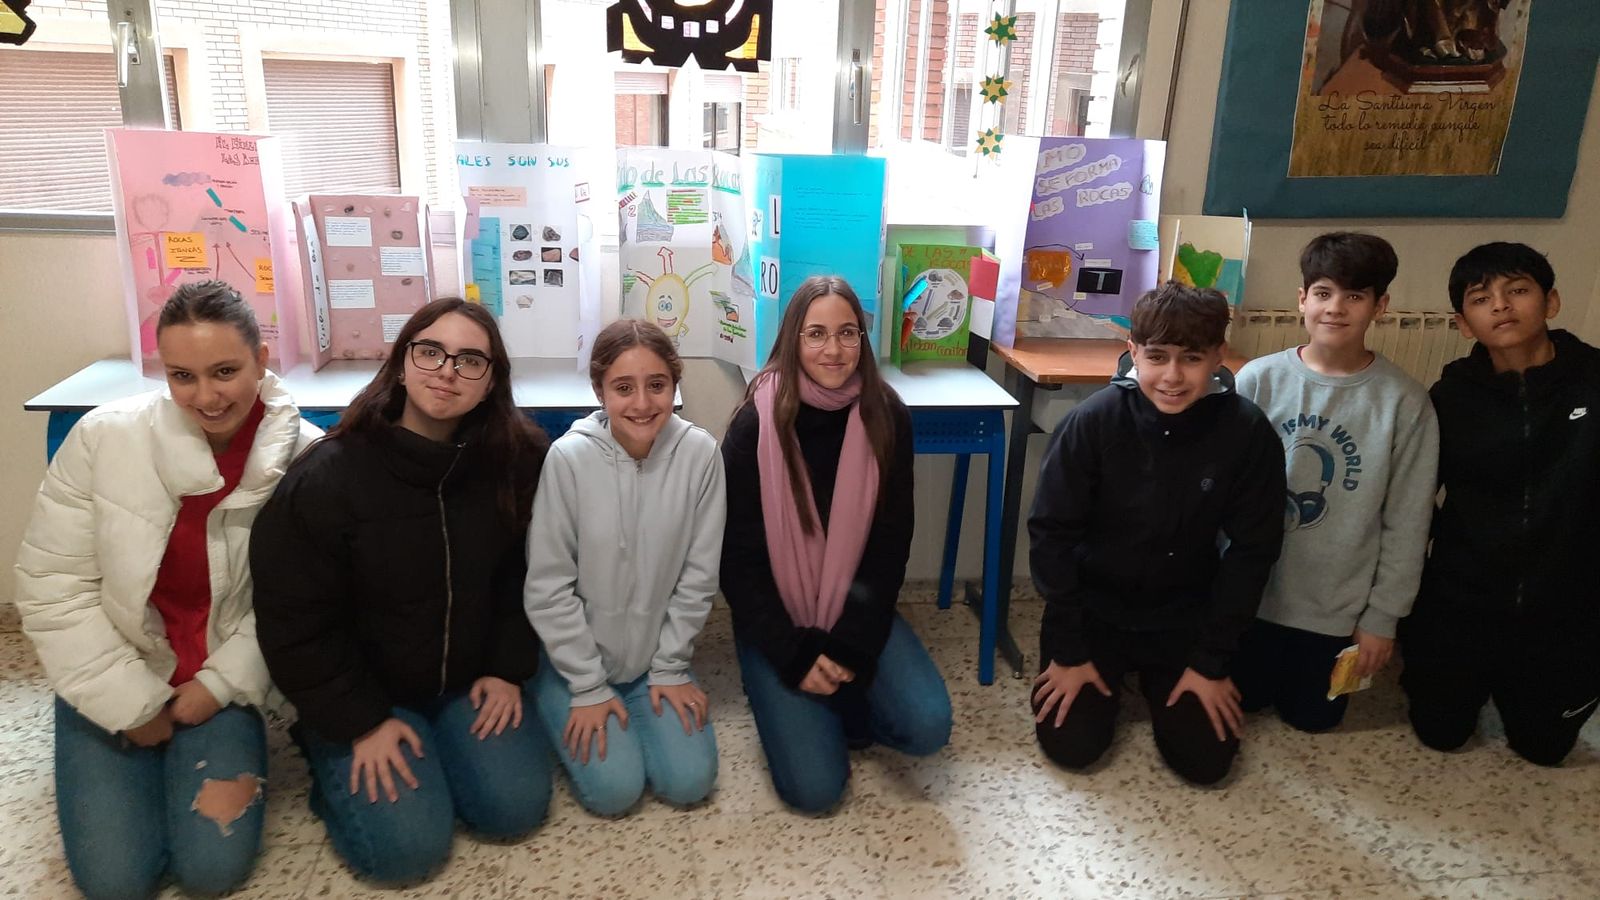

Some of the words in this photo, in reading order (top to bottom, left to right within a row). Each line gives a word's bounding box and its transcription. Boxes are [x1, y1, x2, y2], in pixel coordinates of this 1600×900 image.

[1318, 90, 1350, 111] La
[1439, 87, 1496, 122] Virgen
[1320, 112, 1354, 131] todo
[1357, 111, 1371, 130] lo
[1431, 120, 1480, 143] aunque
[508, 154, 538, 167] SON
[547, 155, 570, 168] SUS
[640, 160, 664, 182] de
[671, 160, 709, 184] Las
[1038, 177, 1061, 195] SE
[1065, 158, 1119, 186] FORMA
[1034, 200, 1060, 217] LAS
[1078, 187, 1130, 205] ROCAS
[1298, 413, 1331, 431] MY
[1330, 424, 1362, 492] WORLD
